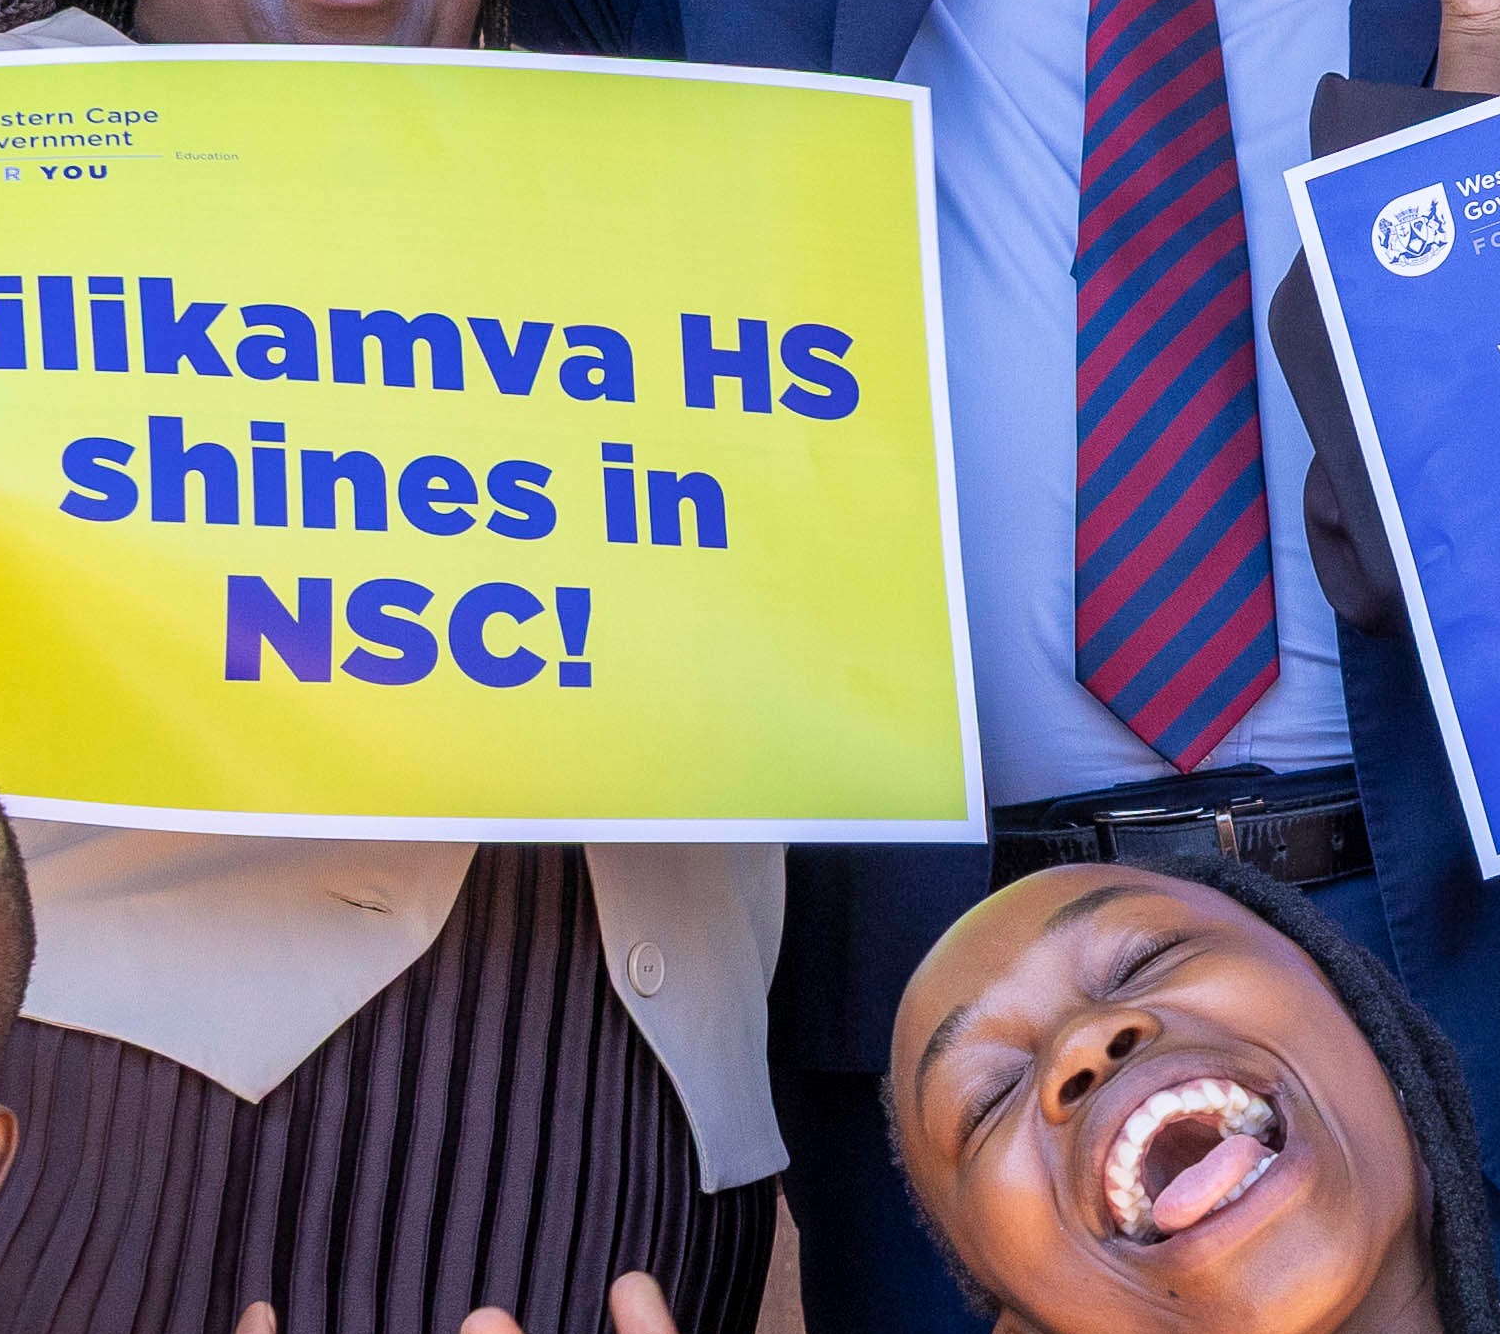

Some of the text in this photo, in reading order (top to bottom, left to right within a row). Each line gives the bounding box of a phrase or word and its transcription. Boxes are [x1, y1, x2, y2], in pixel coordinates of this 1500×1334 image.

[85, 106, 160, 128] Cape
[39, 164, 109, 181] YOU
[175, 149, 240, 161] Education
[681, 313, 860, 422] HS
[57, 414, 729, 550] shines in
[223, 574, 593, 689] NSC!
